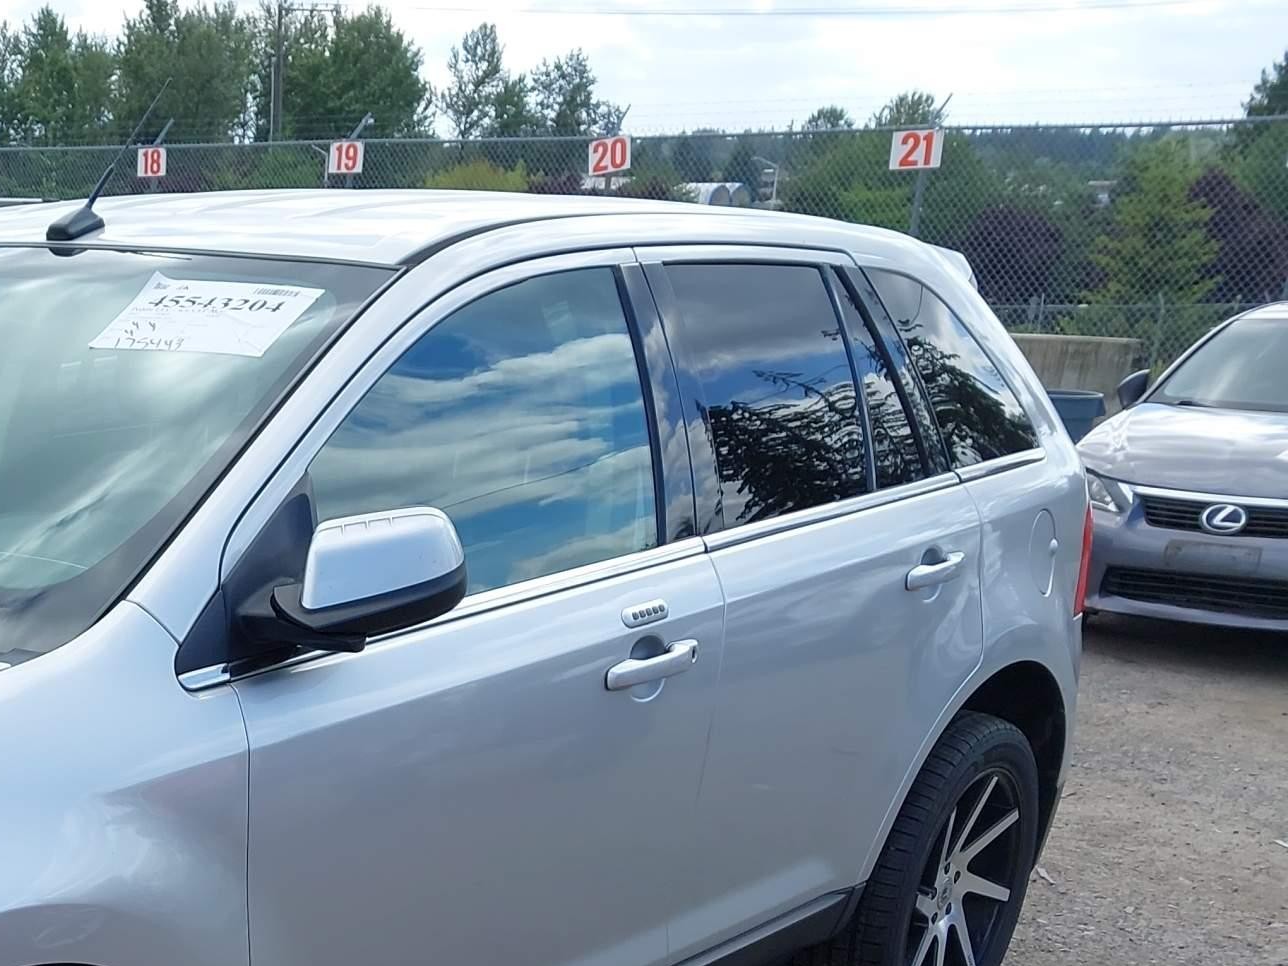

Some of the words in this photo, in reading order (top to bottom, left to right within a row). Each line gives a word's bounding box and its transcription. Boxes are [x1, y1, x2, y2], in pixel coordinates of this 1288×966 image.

[143, 149, 161, 175] 18
[335, 143, 359, 171] 19
[592, 138, 627, 174] 20
[898, 131, 935, 168] 21
[147, 294, 286, 313] 45543204
